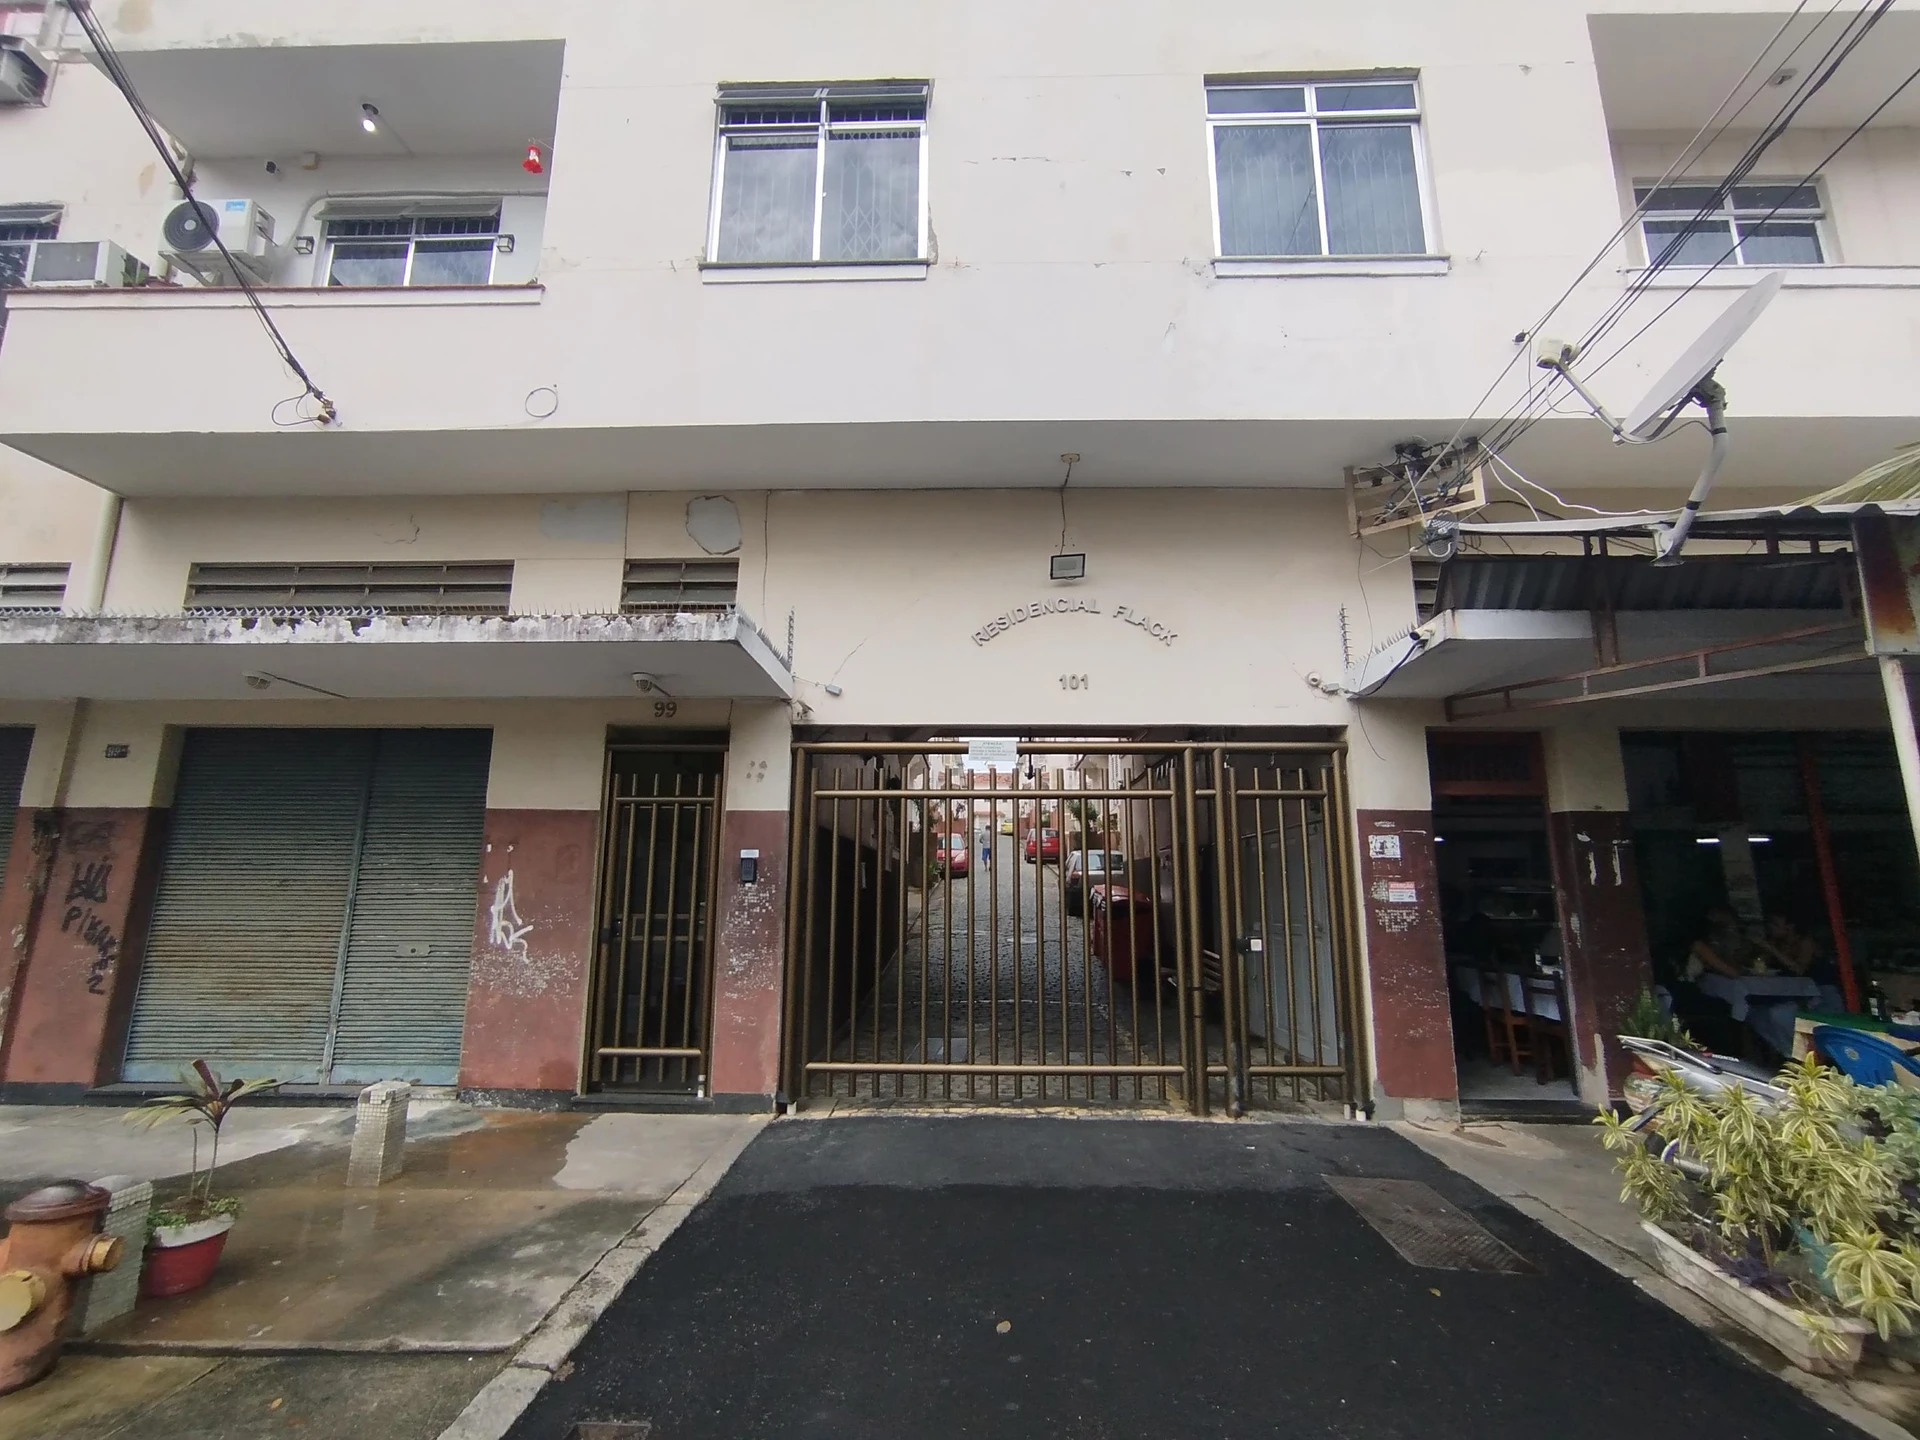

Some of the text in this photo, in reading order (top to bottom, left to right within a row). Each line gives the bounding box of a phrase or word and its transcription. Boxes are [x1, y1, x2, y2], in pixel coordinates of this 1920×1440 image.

[972, 597, 1178, 647] RESIDENCIAL FLACK
[1058, 674, 1089, 690] 101
[654, 701, 677, 718] 99
[1711, 1053, 1740, 1063] HONDA
